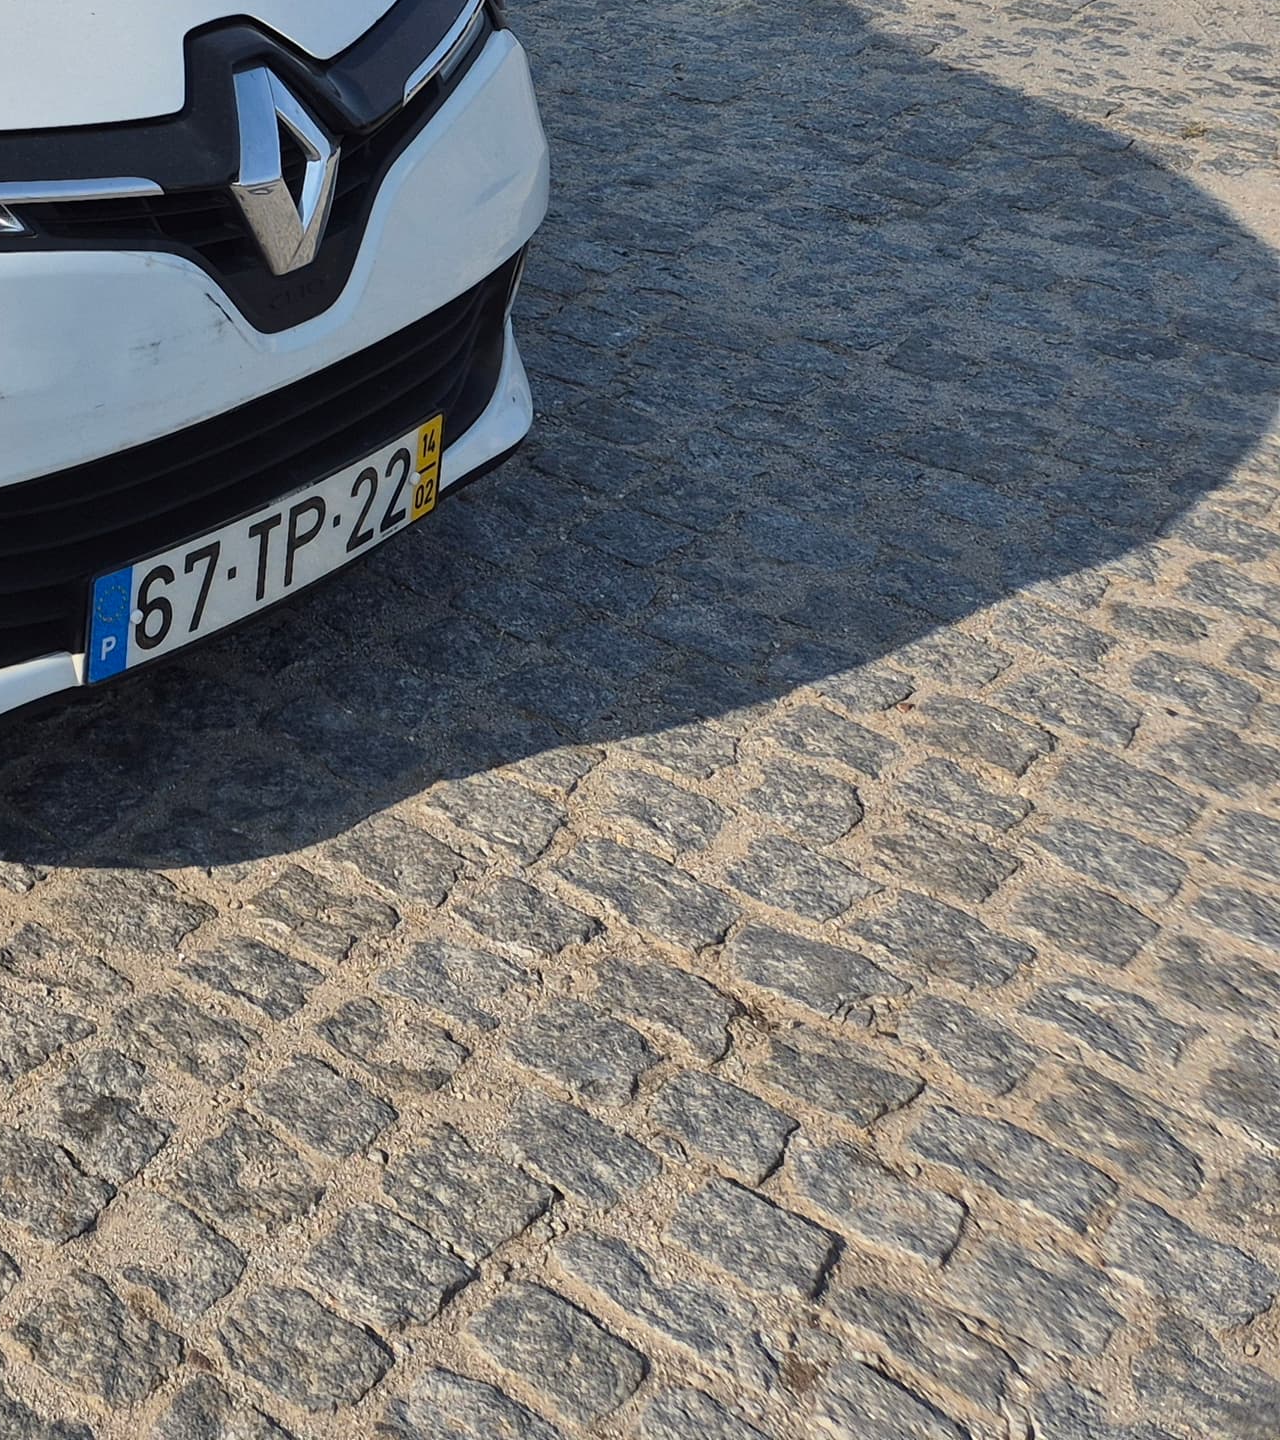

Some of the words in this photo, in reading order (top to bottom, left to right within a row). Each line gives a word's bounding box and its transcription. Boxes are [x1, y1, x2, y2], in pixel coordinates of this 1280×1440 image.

[423, 428, 436, 458] 14
[414, 478, 434, 510] 02
[101, 636, 117, 662] P
